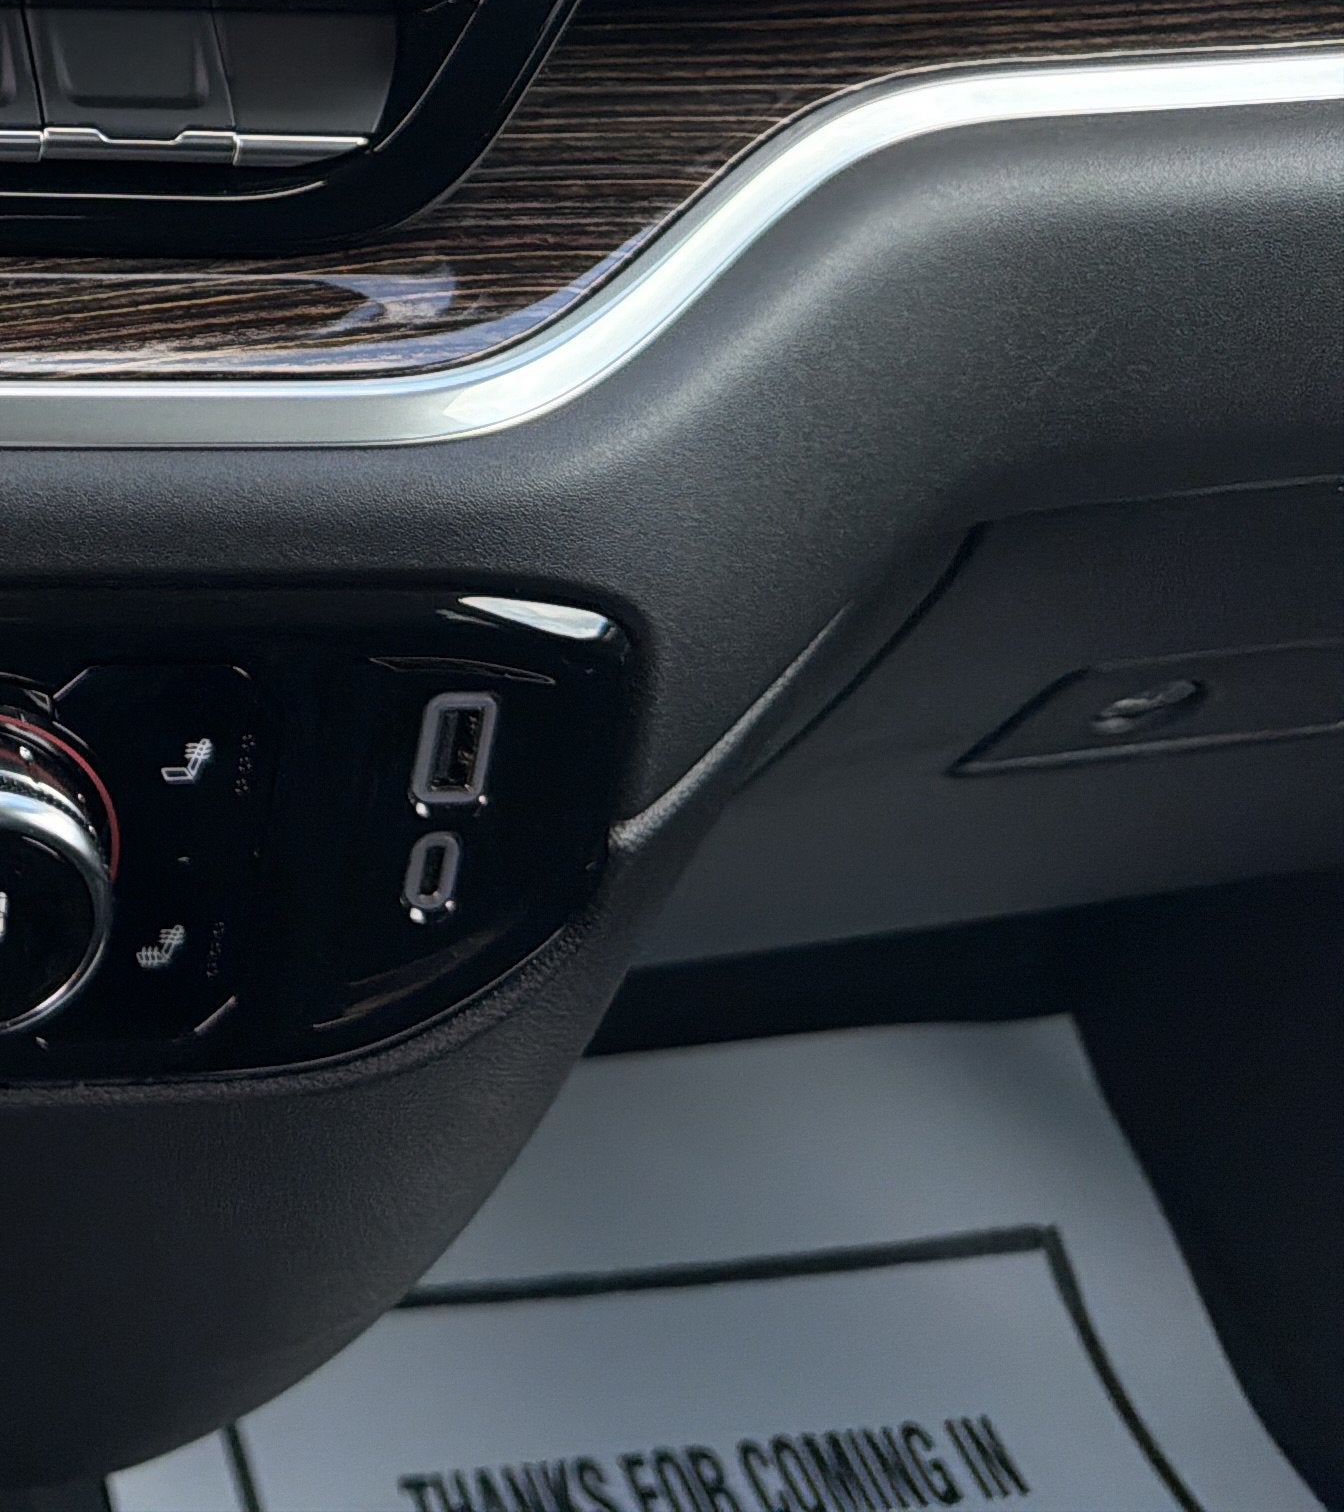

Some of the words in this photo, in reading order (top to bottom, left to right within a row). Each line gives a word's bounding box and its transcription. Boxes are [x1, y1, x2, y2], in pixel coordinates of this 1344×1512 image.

[617, 1443, 746, 1512] FOR
[736, 1420, 965, 1512] COMING
[943, 1413, 1032, 1499] IN
